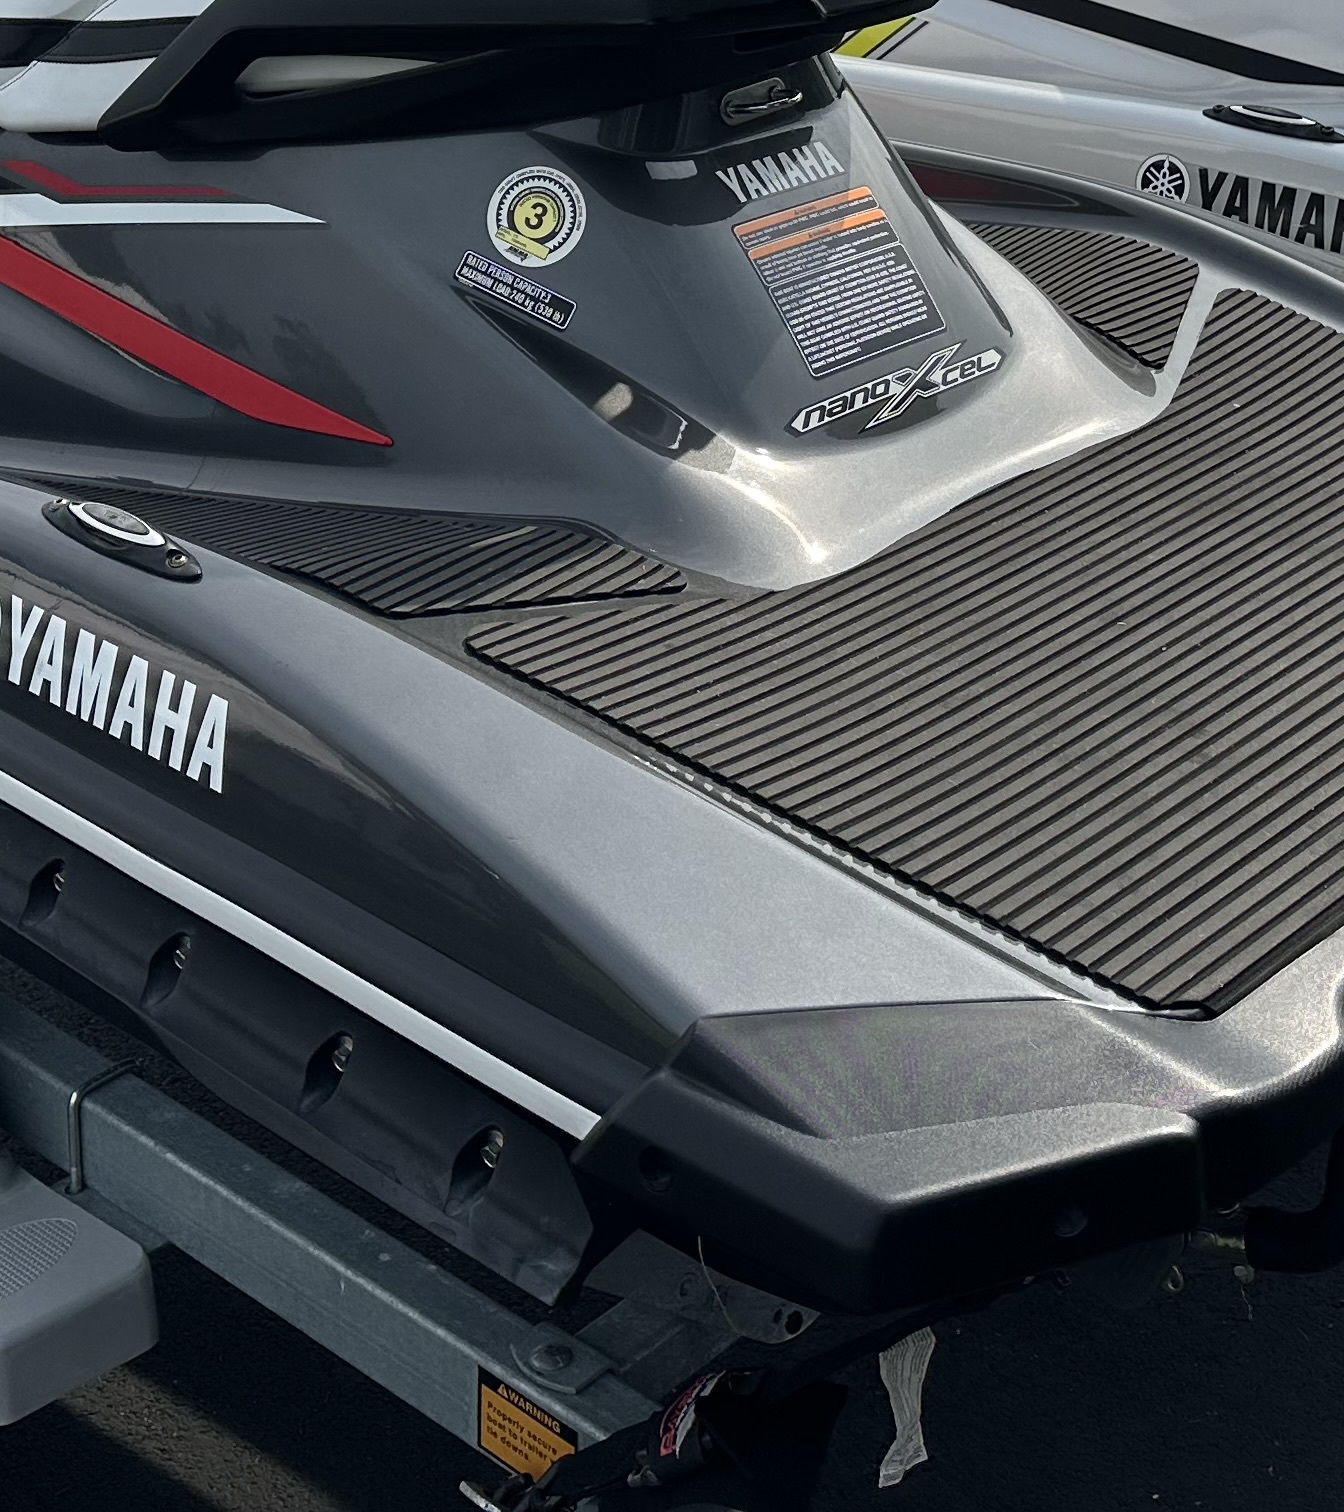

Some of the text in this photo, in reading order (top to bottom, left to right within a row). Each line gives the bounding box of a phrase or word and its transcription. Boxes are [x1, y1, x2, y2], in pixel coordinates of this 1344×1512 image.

[715, 141, 845, 203] YAMAHA
[524, 202, 548, 230] 3
[460, 265, 495, 289] MAXIMUM
[525, 294, 536, 311] kg
[466, 254, 488, 271] RATED
[487, 263, 515, 285] PERSON
[8, 594, 229, 794] YAMAHA
[486, 1425, 498, 1439] tie
[487, 1400, 558, 1456] Properly secure
[508, 1389, 561, 1434] WARNING
[486, 1412, 548, 1461] boat to trailer
